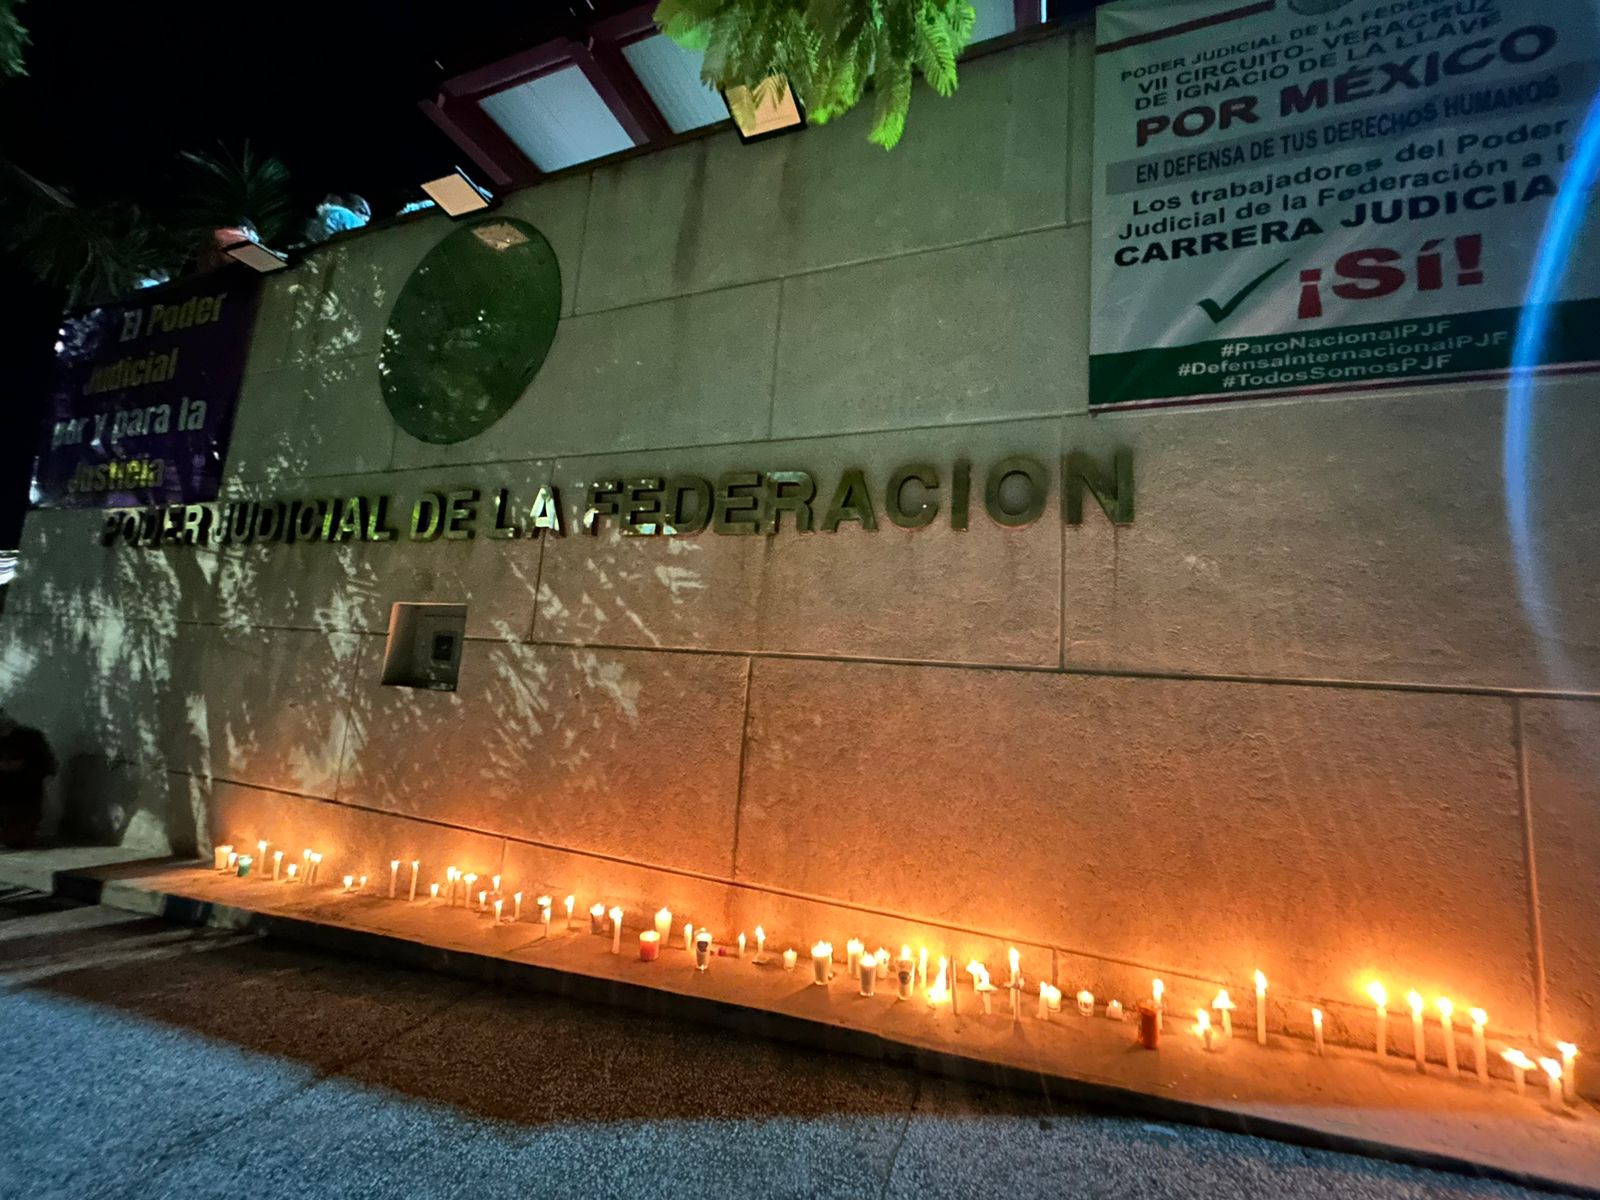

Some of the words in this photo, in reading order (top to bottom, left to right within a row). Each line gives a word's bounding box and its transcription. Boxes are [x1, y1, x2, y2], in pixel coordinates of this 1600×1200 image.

[1121, 58, 1185, 82] PODER
[1192, 35, 1283, 65] JUDICIAL
[1290, 25, 1318, 40] DE
[1326, 17, 1352, 31] LA
[1135, 92, 1168, 111] DE
[1176, 64, 1290, 102] IGNACIO
[1299, 52, 1337, 73] DE
[1347, 42, 1386, 61] LA
[1396, 11, 1502, 49] LLAVE
[1138, 76, 1168, 94] VII
[1323, 0, 1494, 50] VERACRUZ
[1136, 95, 1261, 148] POR
[1280, 24, 1558, 117] MÉXICO
[1133, 195, 1181, 216] Los
[1190, 157, 1384, 206] trabajadores
[1395, 139, 1444, 163] del
[1457, 119, 1569, 154] Poder
[1136, 162, 1158, 184] EN
[1164, 146, 1245, 179] DEFENSA
[1250, 138, 1274, 161] DE
[1280, 129, 1317, 155] TUS
[1323, 101, 1438, 145] DERECHOS
[1444, 78, 1561, 118] HUMANOS
[1118, 207, 1225, 240] Judicial
[1235, 202, 1271, 220] de
[1282, 194, 1307, 212] la
[1318, 157, 1508, 206] Federación
[1521, 152, 1542, 168] a
[1114, 217, 1323, 267] CARRERA
[119, 308, 143, 342] El
[147, 292, 228, 336] Poder
[1178, 331, 1508, 376] #DefensaInternacionalPJF
[1220, 320, 1452, 357] #ParoNacionalPJF
[1222, 354, 1453, 388] #TodosSomosPJF
[111, 402, 172, 445] para
[178, 396, 207, 431] la
[102, 502, 205, 547] PODER
[208, 494, 391, 545] JUDICIAL
[408, 489, 478, 542] DE
[490, 485, 565, 538] LA
[585, 447, 1136, 537] FEDERACION
